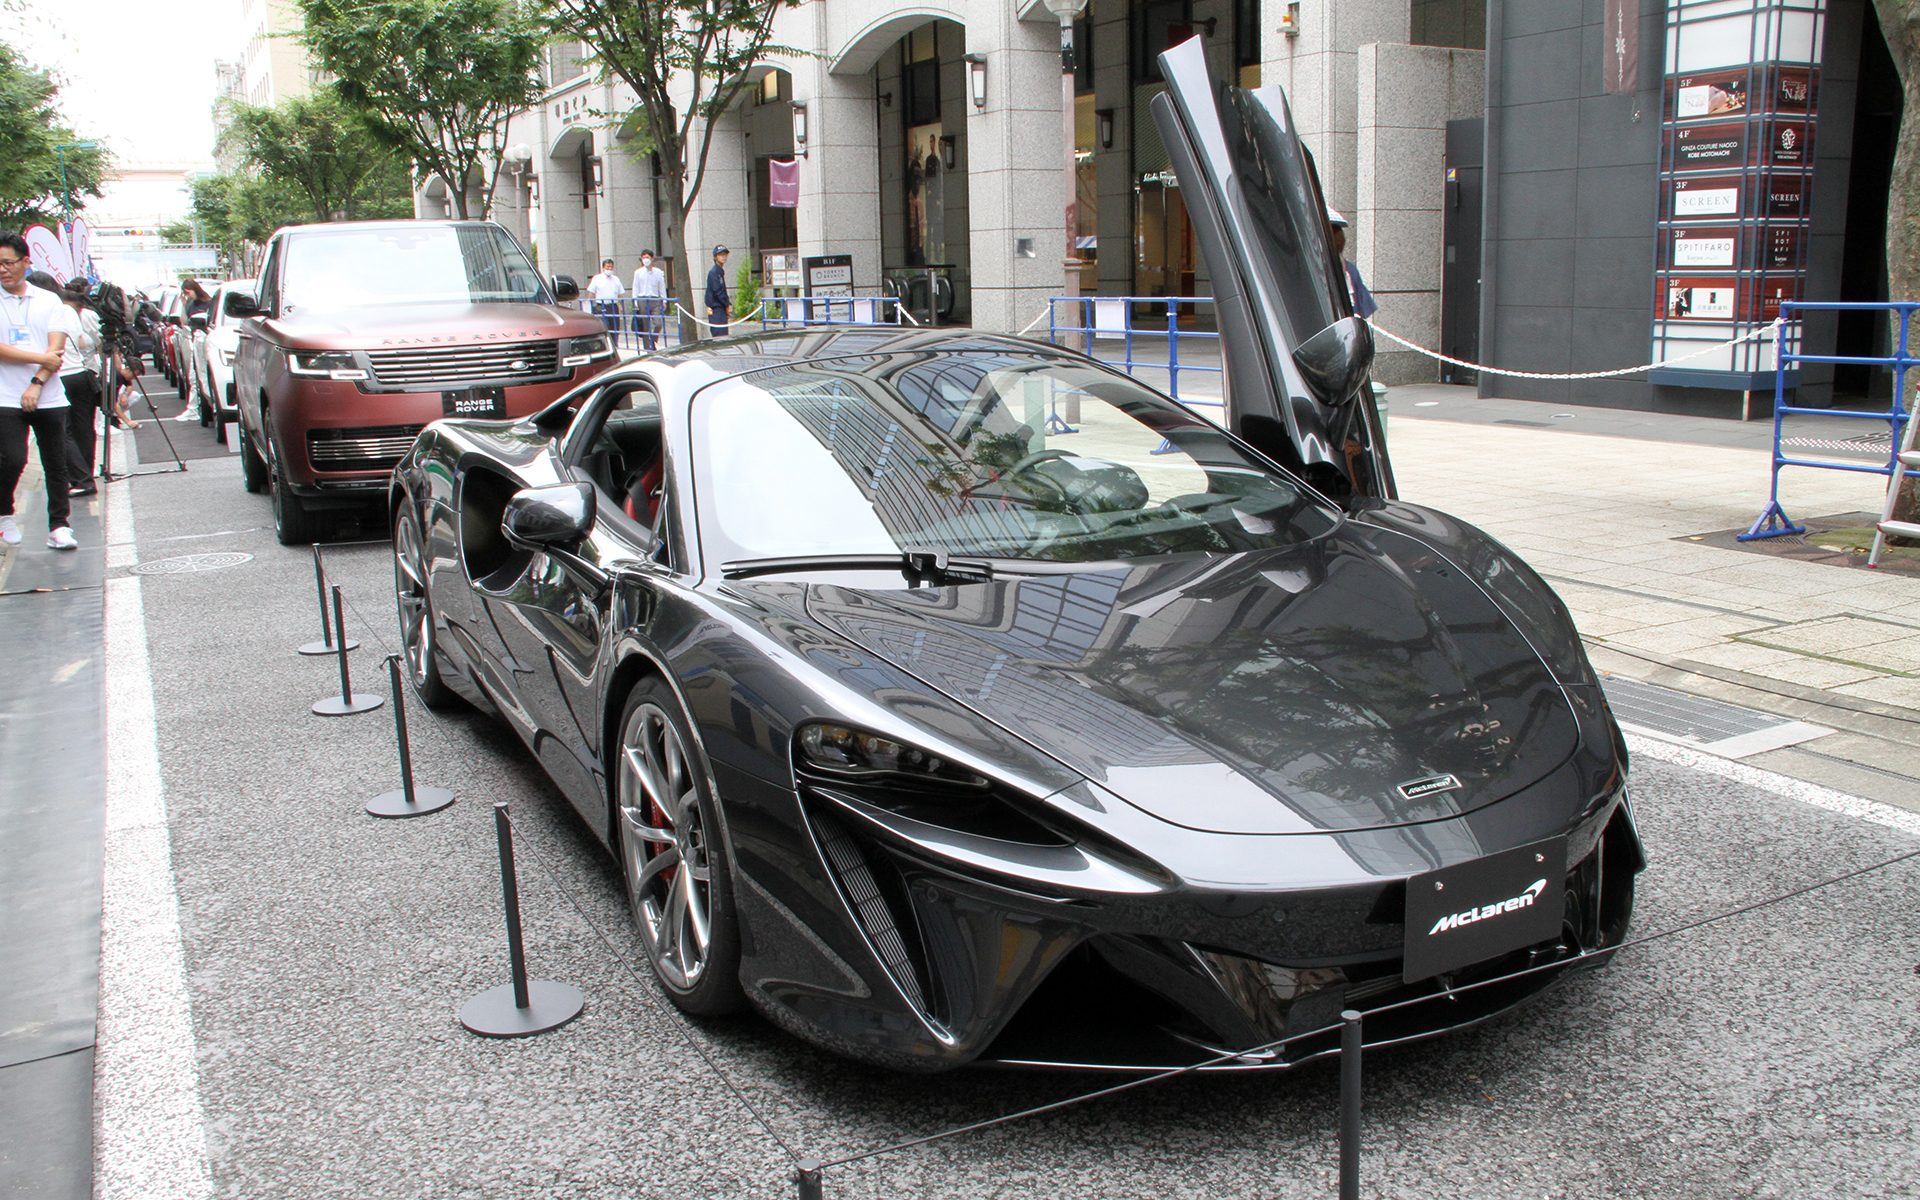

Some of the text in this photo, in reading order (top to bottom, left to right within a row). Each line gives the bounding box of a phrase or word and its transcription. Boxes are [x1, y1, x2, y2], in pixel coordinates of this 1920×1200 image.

[1680, 79, 1692, 87] 5F
[1678, 130, 1691, 139] 4F
[1675, 181, 1688, 189] 3F
[1682, 195, 1731, 206] SCREEN
[1770, 193, 1800, 202] SCREEN
[1674, 230, 1686, 238] 3F
[1677, 243, 1731, 251] SPITIFARO
[382, 330, 542, 344] RANGE ROVER
[455, 399, 493, 407] RANGE
[456, 404, 494, 413] ROVER
[1407, 778, 1450, 795] McLaren
[1428, 893, 1535, 936] McLaren
